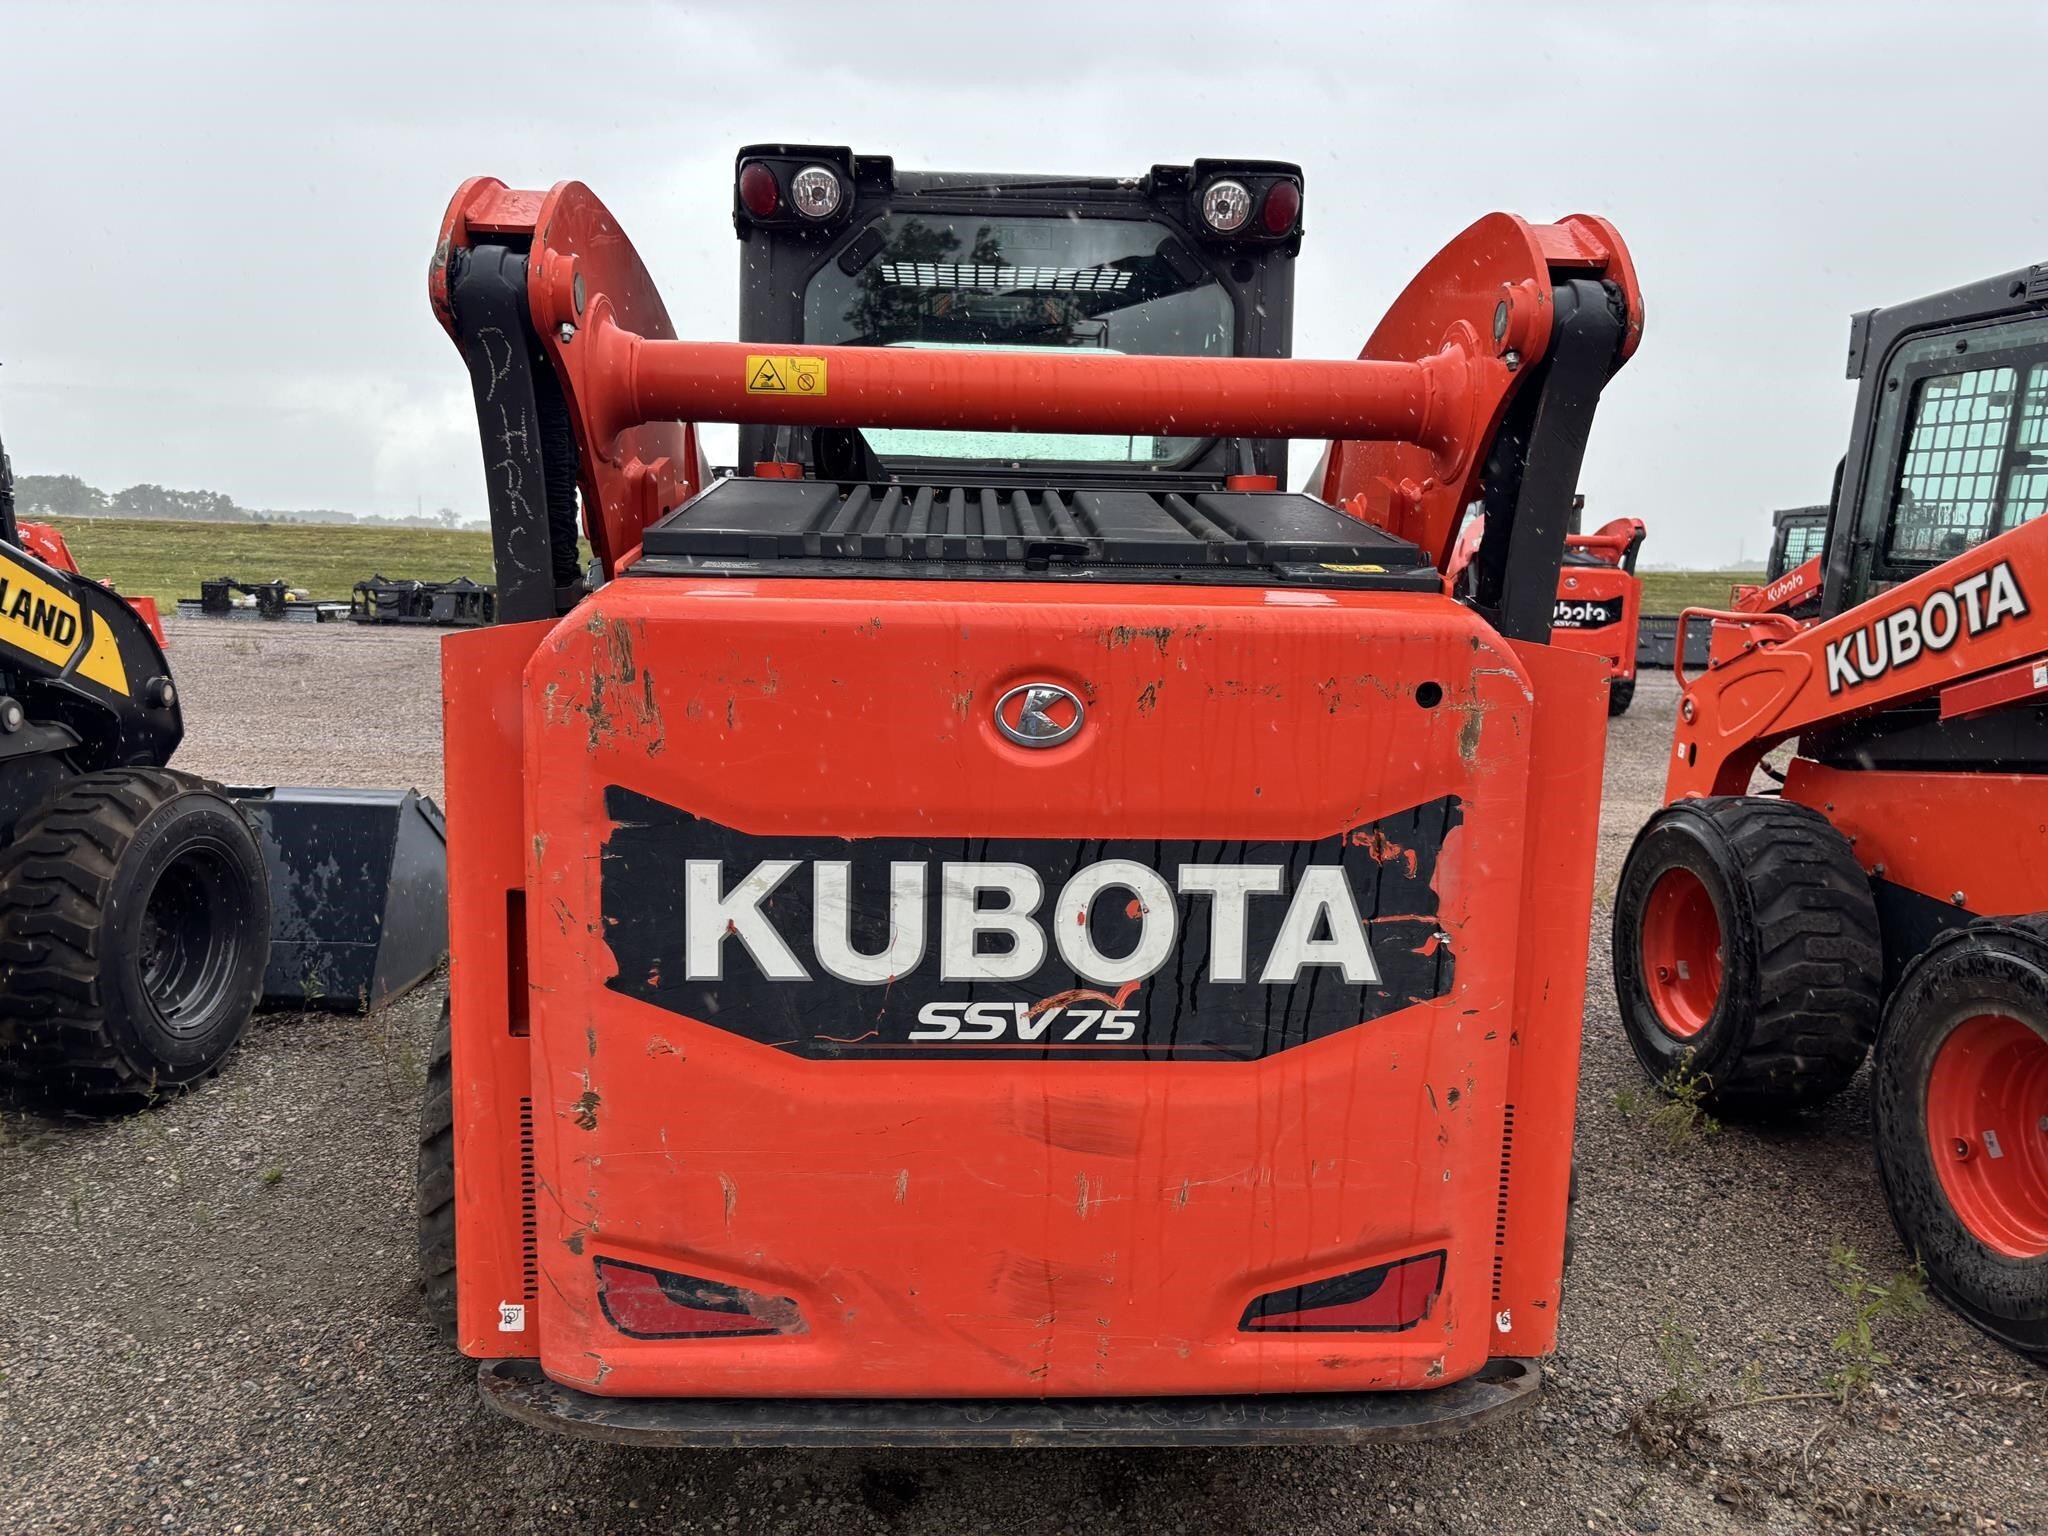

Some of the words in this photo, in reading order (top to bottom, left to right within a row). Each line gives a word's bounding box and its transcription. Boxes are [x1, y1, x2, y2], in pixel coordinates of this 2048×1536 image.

[1767, 574, 1804, 602] Kubota
[1825, 561, 2028, 694] KUBOTA
[684, 858, 1384, 985] KUBOTA
[908, 1001, 1141, 1041] SSV75
